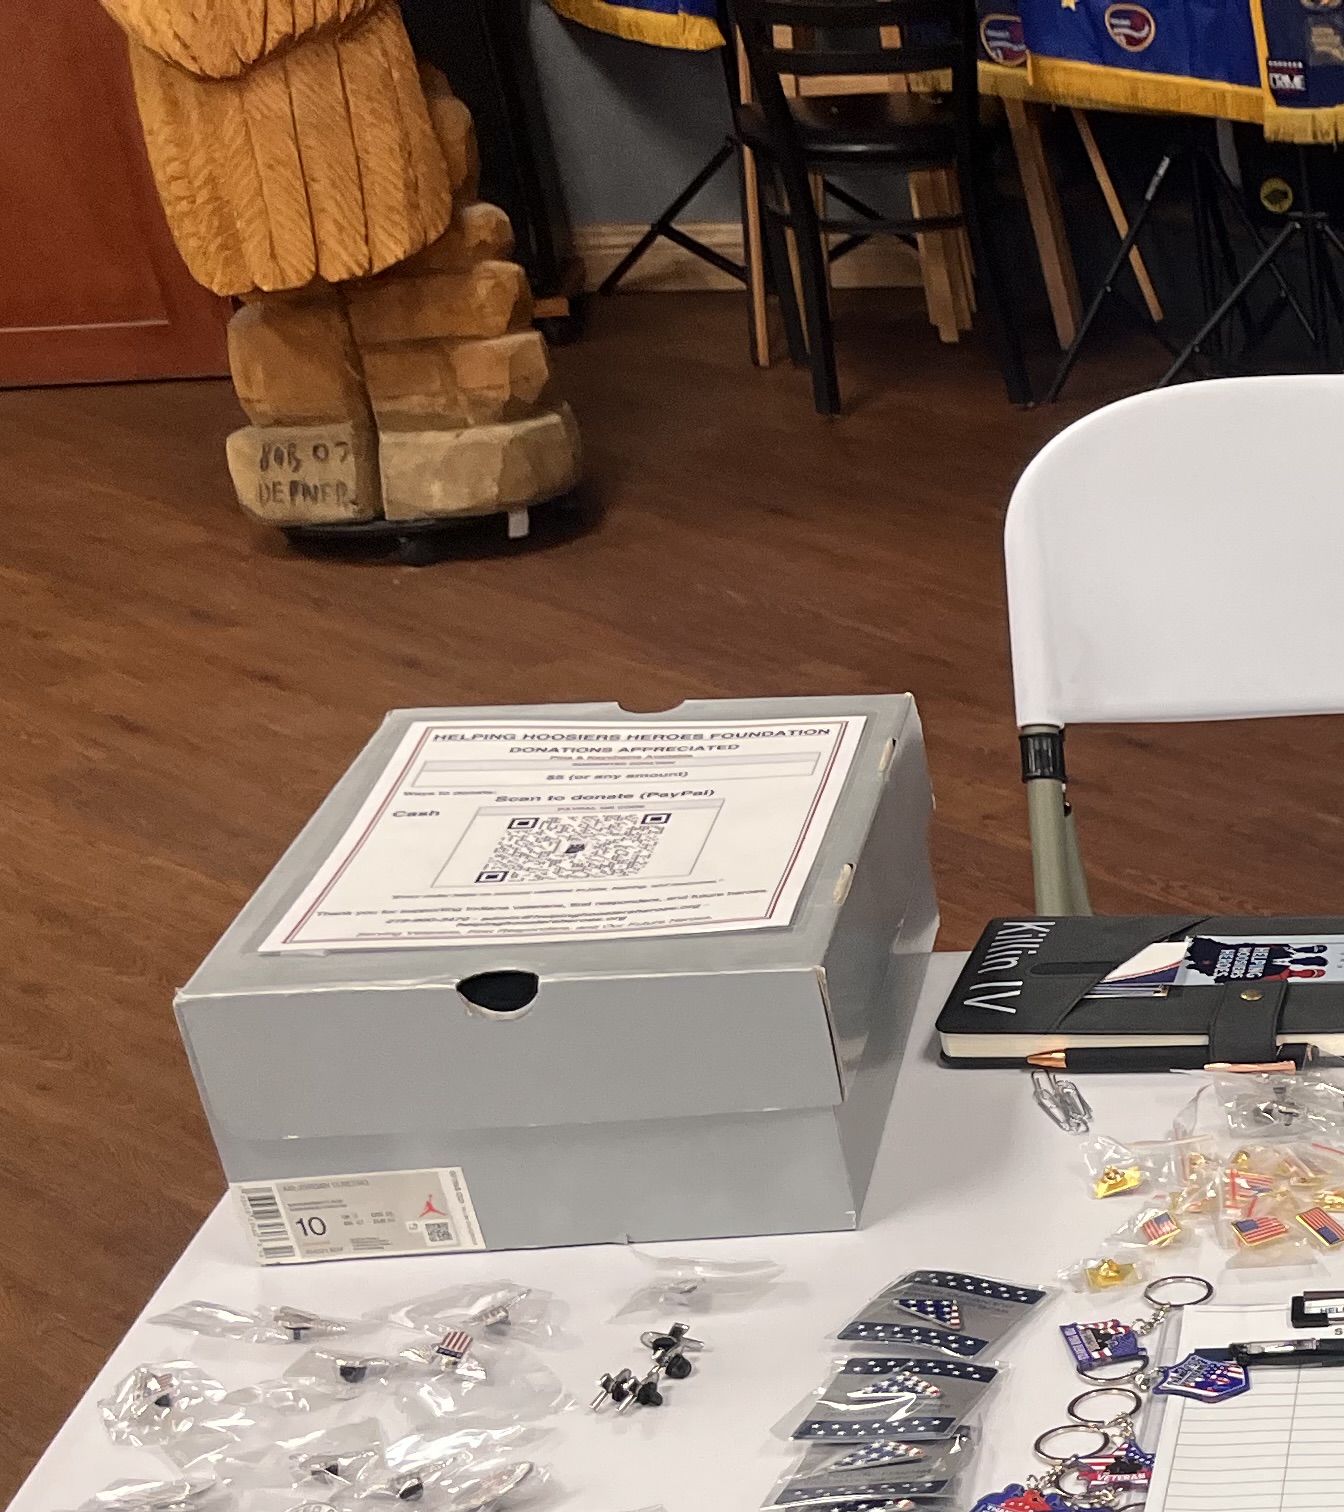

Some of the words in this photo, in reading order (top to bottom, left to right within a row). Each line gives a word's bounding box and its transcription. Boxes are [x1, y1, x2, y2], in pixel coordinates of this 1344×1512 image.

[710, 728, 830, 740] FOUNDATION
[618, 744, 740, 752] APPRECIATED
[495, 794, 542, 803] Scan
[571, 792, 635, 801] donate
[639, 788, 715, 801] (PayPal)
[393, 809, 440, 818] Cash
[979, 921, 1056, 974] Killin
[964, 980, 1023, 1014] IV
[295, 1216, 327, 1236] 10
[1097, 1473, 1146, 1481] VETERAN
